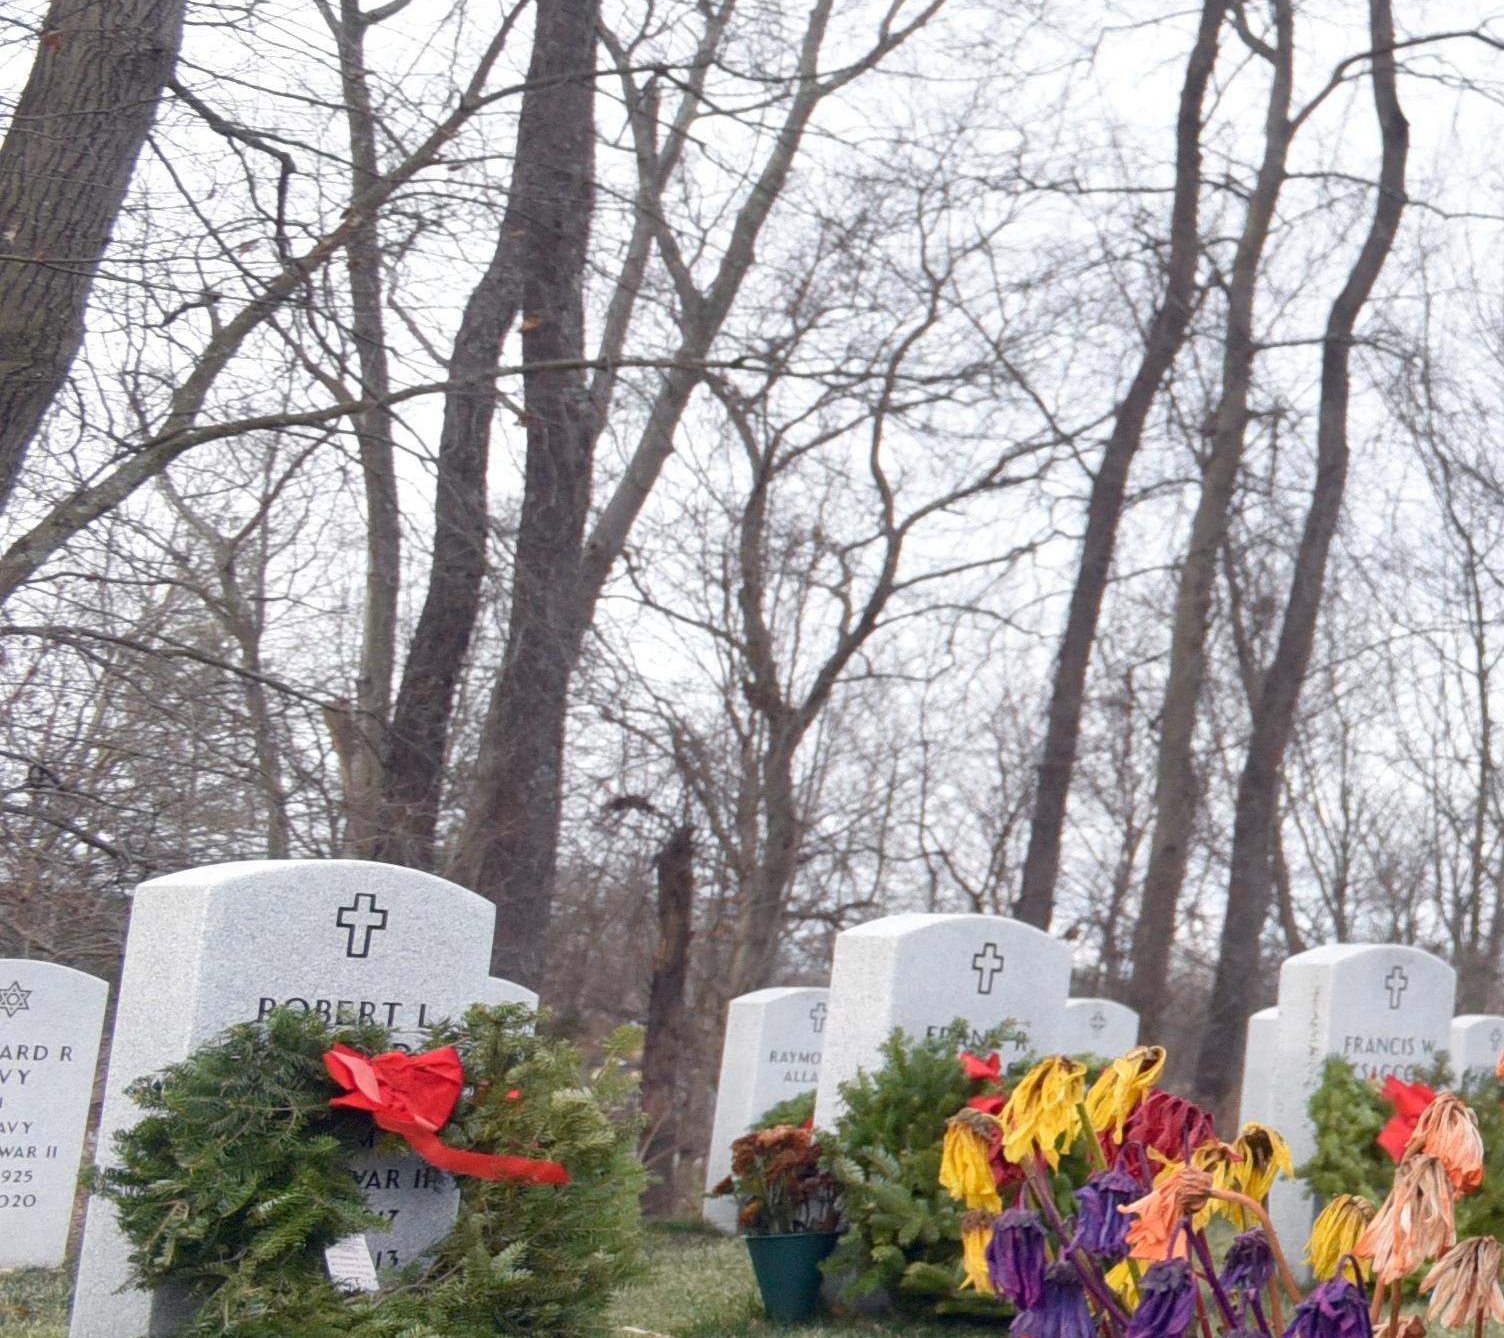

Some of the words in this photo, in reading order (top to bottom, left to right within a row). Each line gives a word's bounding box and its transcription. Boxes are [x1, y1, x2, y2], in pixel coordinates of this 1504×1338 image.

[258, 997, 403, 1027] ROBERT
[418, 1003, 433, 1027] L
[59, 1046, 72, 1061] R
[1344, 1036, 1415, 1056] FRANCIS
[0, 1145, 37, 1159] WAR
[45, 1145, 58, 1158] II
